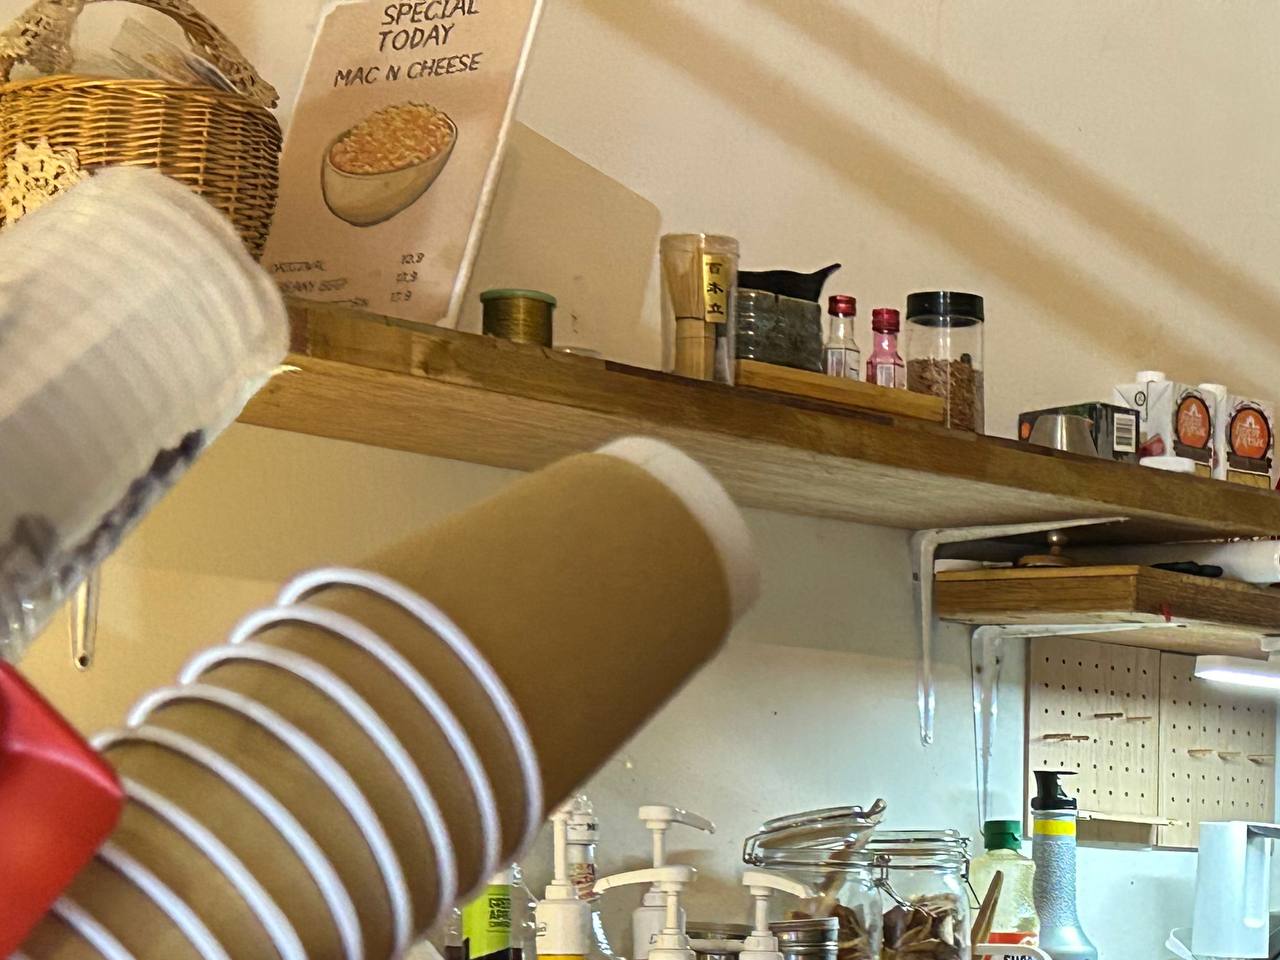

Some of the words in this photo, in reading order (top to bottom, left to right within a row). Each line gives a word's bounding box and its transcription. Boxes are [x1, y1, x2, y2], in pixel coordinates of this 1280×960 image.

[381, 0, 480, 26] SPECIAL
[379, 23, 455, 52] TODAY
[334, 66, 380, 87] MAC
[386, 65, 401, 81] N
[407, 52, 483, 80] CHEESE
